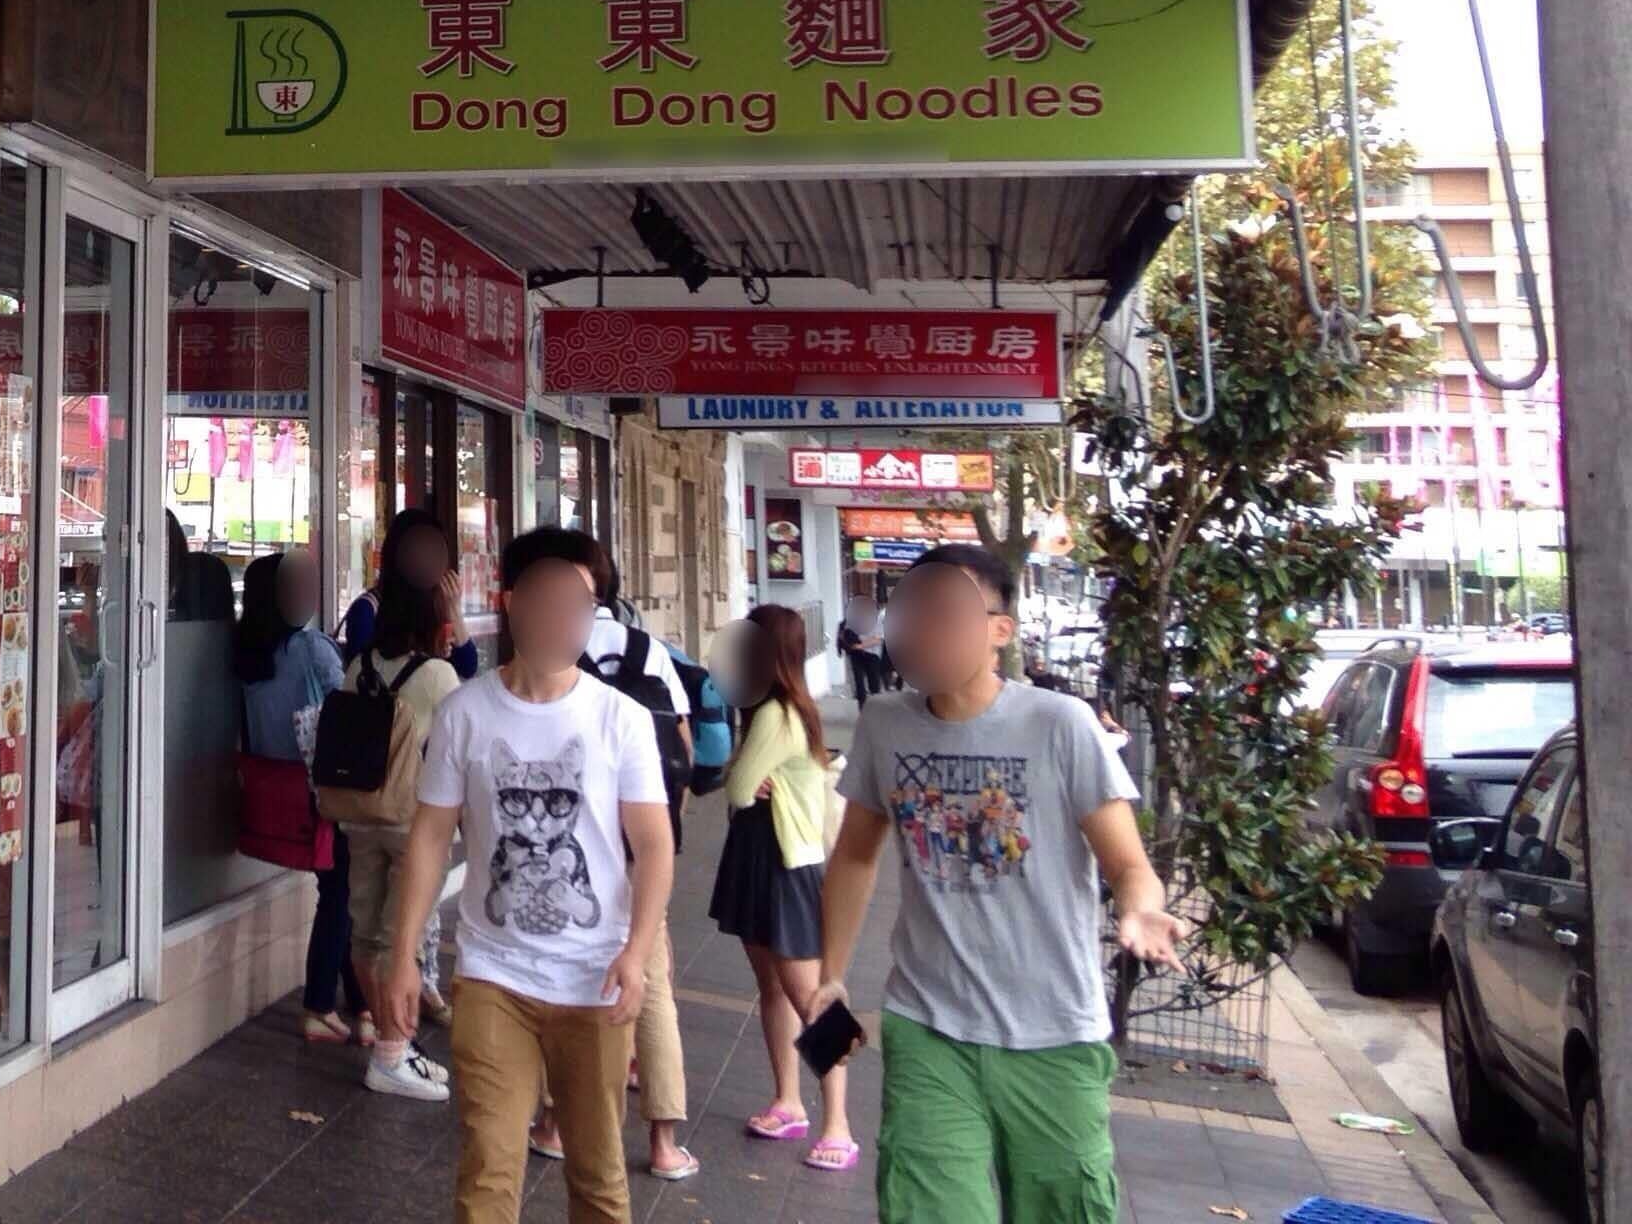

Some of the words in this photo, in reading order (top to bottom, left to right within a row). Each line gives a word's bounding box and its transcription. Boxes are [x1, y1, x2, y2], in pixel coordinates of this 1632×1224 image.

[411, 90, 569, 138] Dong
[612, 84, 779, 133] Dong
[824, 76, 1104, 122] Noodles
[800, 360, 877, 374] KITCHEN
[884, 361, 1041, 376] ENLIGHTENMENT
[688, 398, 808, 421] LAUNDRY
[820, 399, 840, 420] &
[855, 400, 1025, 419] ALTERATION
